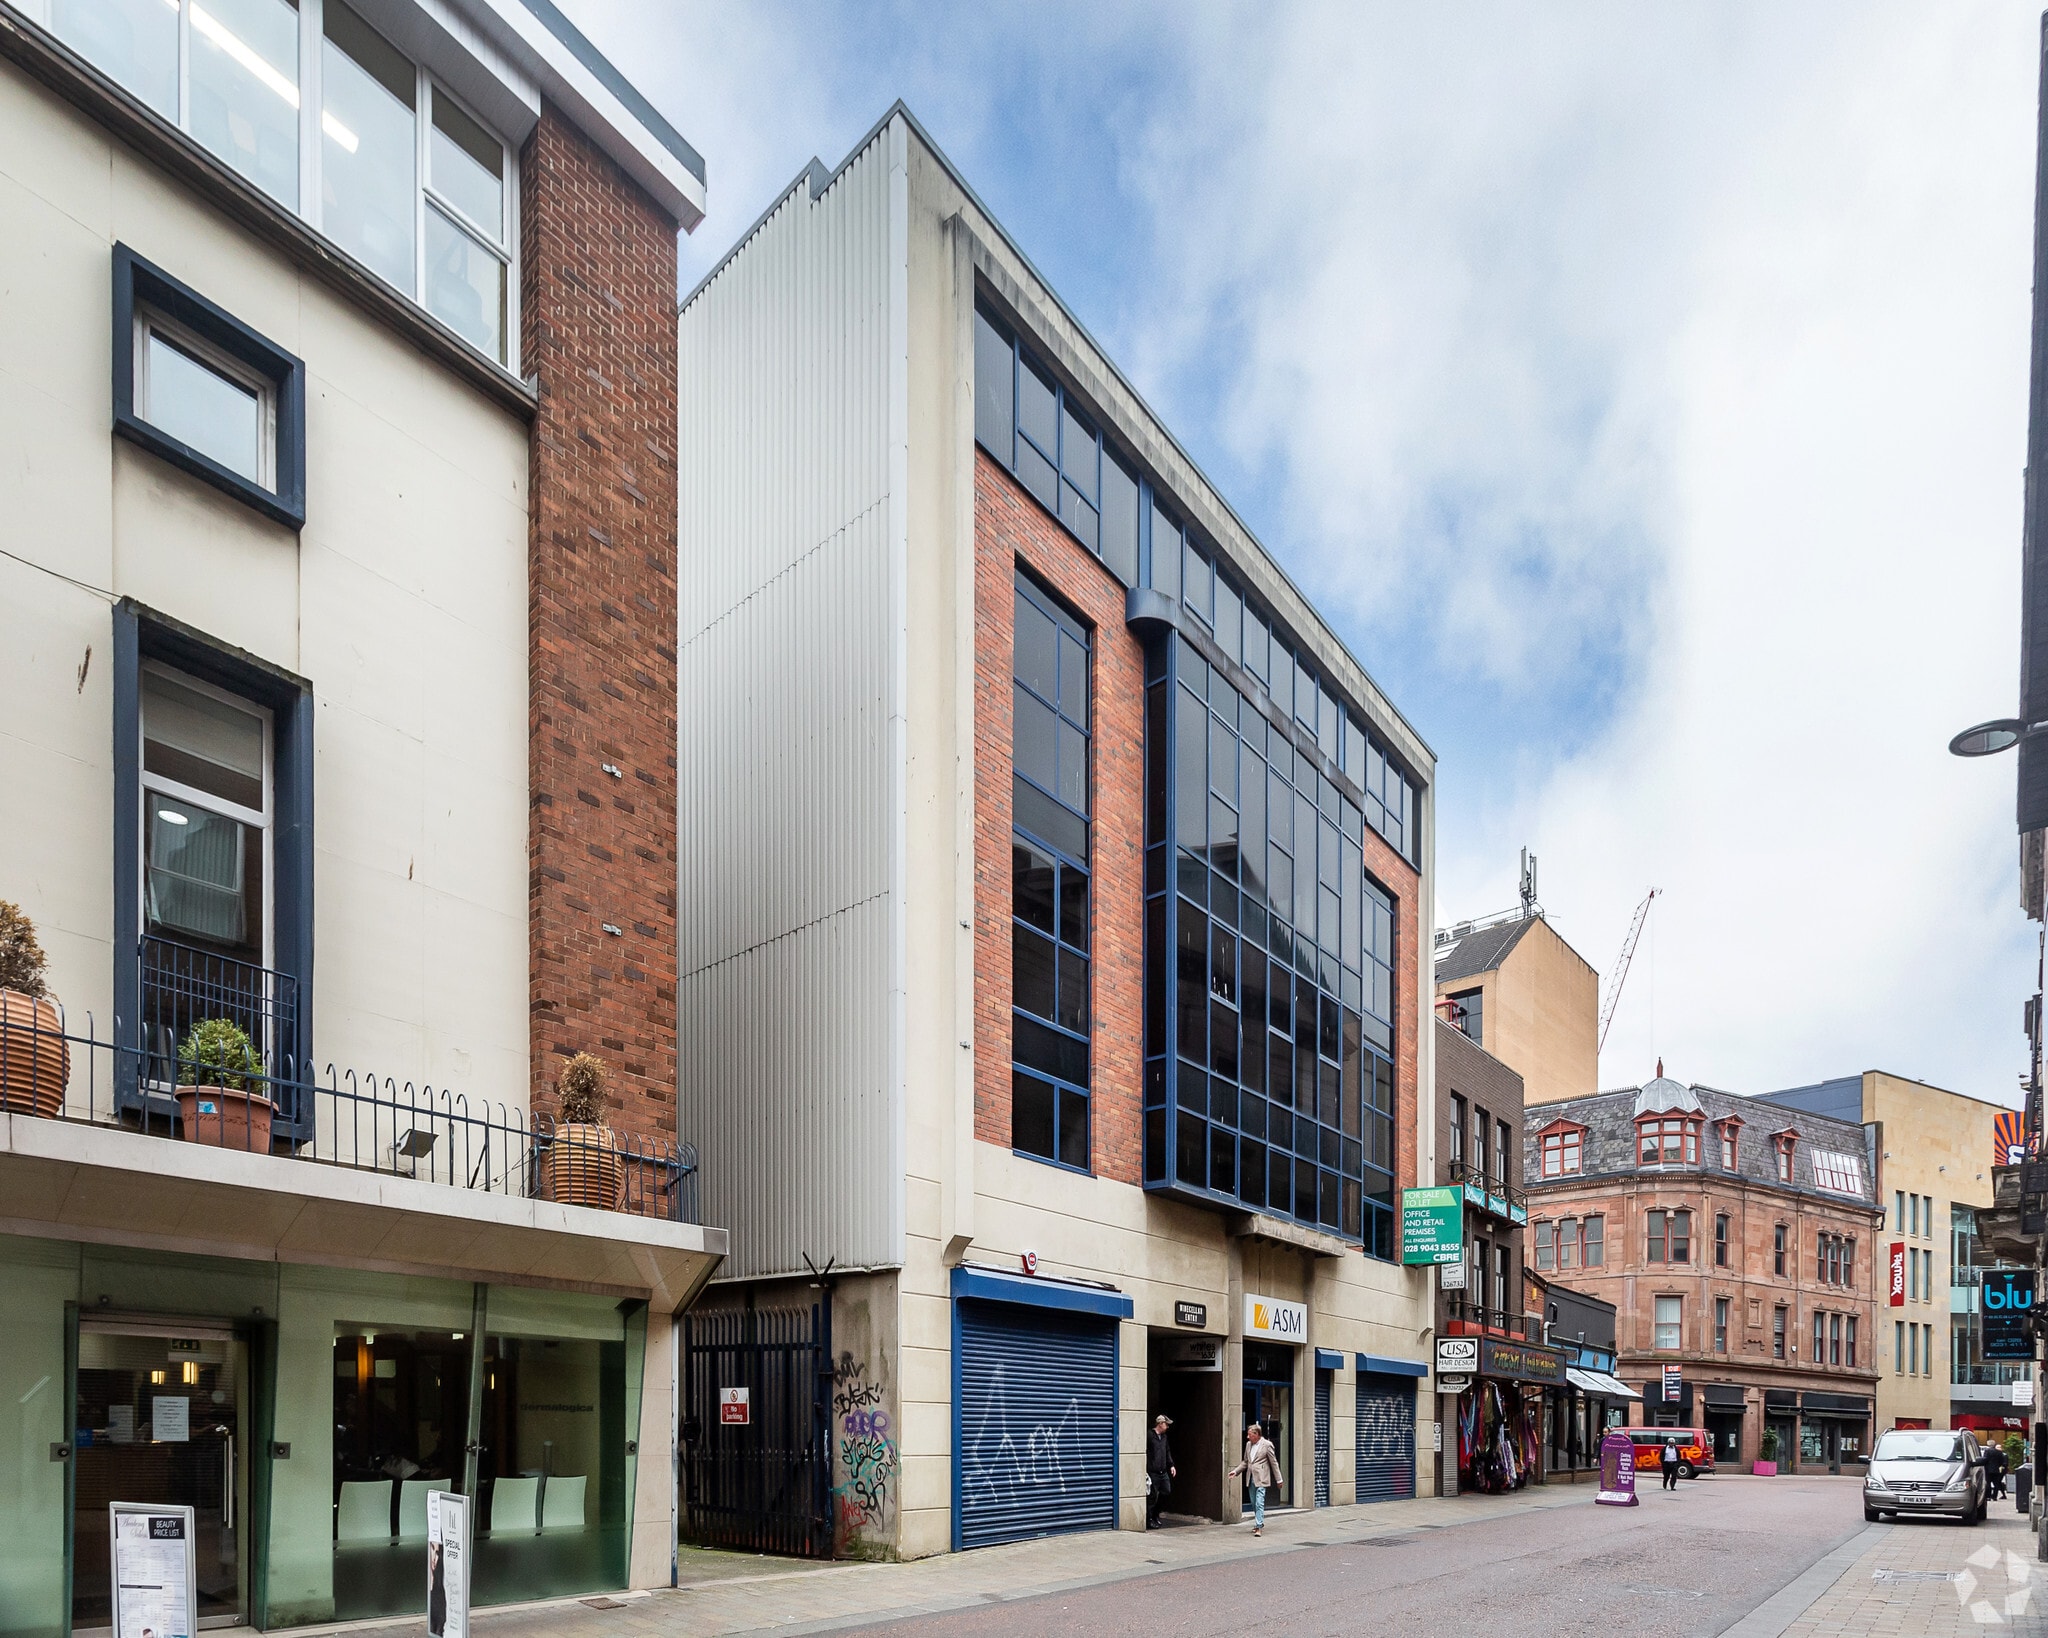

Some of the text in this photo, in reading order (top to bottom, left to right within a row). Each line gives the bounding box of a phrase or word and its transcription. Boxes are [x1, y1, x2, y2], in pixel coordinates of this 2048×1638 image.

[1404, 1192, 1420, 1200] FOR
[1422, 1190, 1439, 1198] SALE
[1418, 1199, 1431, 1207] LET
[1404, 1210, 1430, 1218] OFFICE
[1422, 1218, 1445, 1226] RETAIL
[1404, 1228, 1436, 1236] PREMISES
[1404, 1243, 1459, 1253] 028 9043 8555
[1433, 1253, 1460, 1262] CBRE
[1984, 1283, 2032, 1310] blu
[1184, 1313, 1198, 1323] ENTRY
[1272, 1307, 1301, 1334] ASM
[1446, 1343, 1469, 1355] LISA
[520, 1403, 594, 1413] dermalogica
[726, 1413, 743, 1422] parking
[156, 1520, 177, 1529] BEAUTY
[153, 1529, 180, 1537] PRICE LIST
[445, 1539, 461, 1551] SPECIAL
[447, 1550, 459, 1560] OFFER
